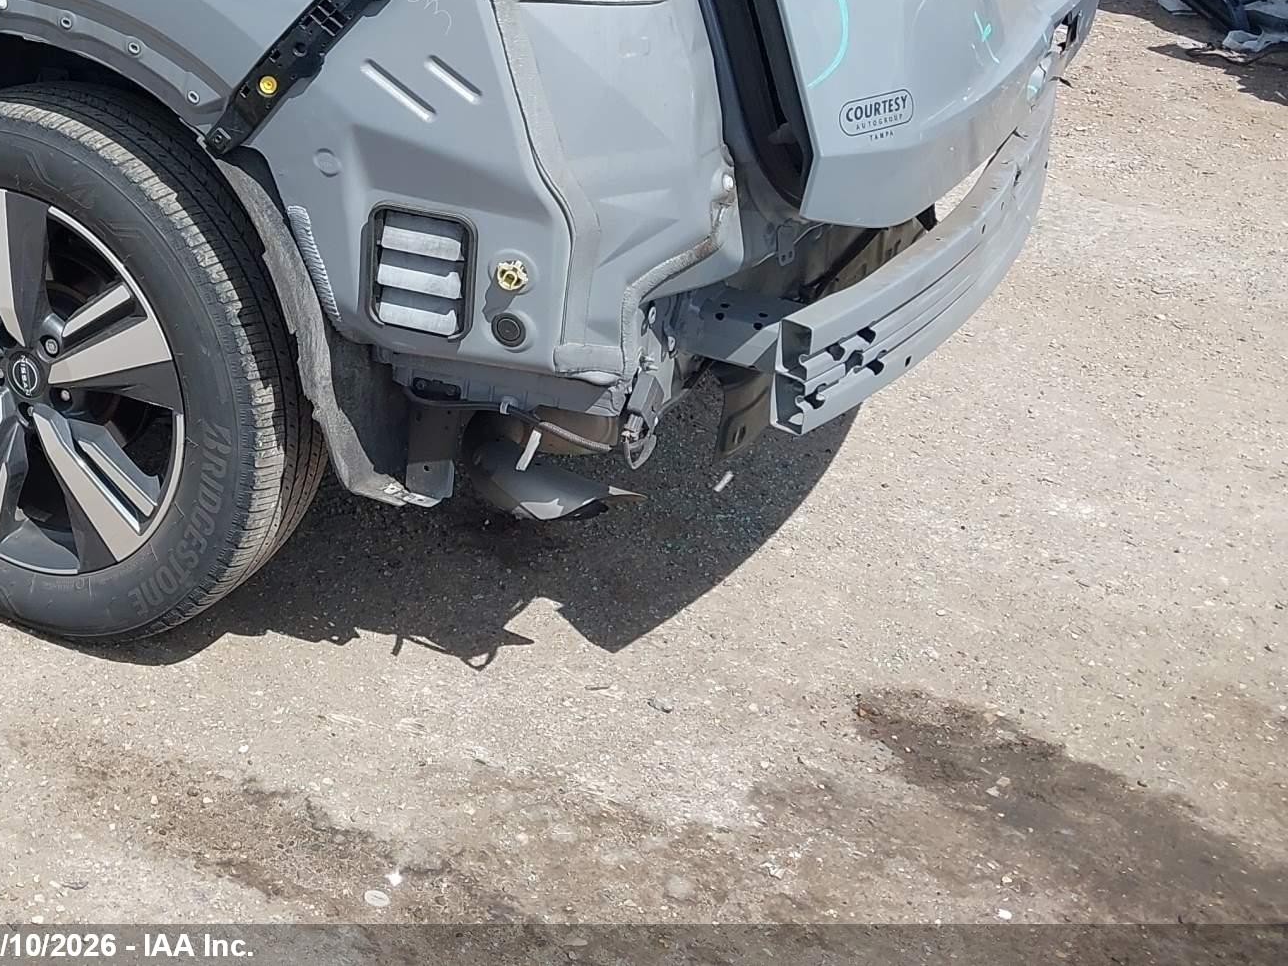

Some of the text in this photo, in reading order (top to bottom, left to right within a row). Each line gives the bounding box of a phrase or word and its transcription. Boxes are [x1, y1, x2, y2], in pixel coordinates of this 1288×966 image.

[846, 95, 908, 122] COURTESY
[856, 114, 903, 130] AUTOGROUP
[870, 132, 894, 141] TAMPA
[127, 419, 232, 617] BRIDGESTONE
